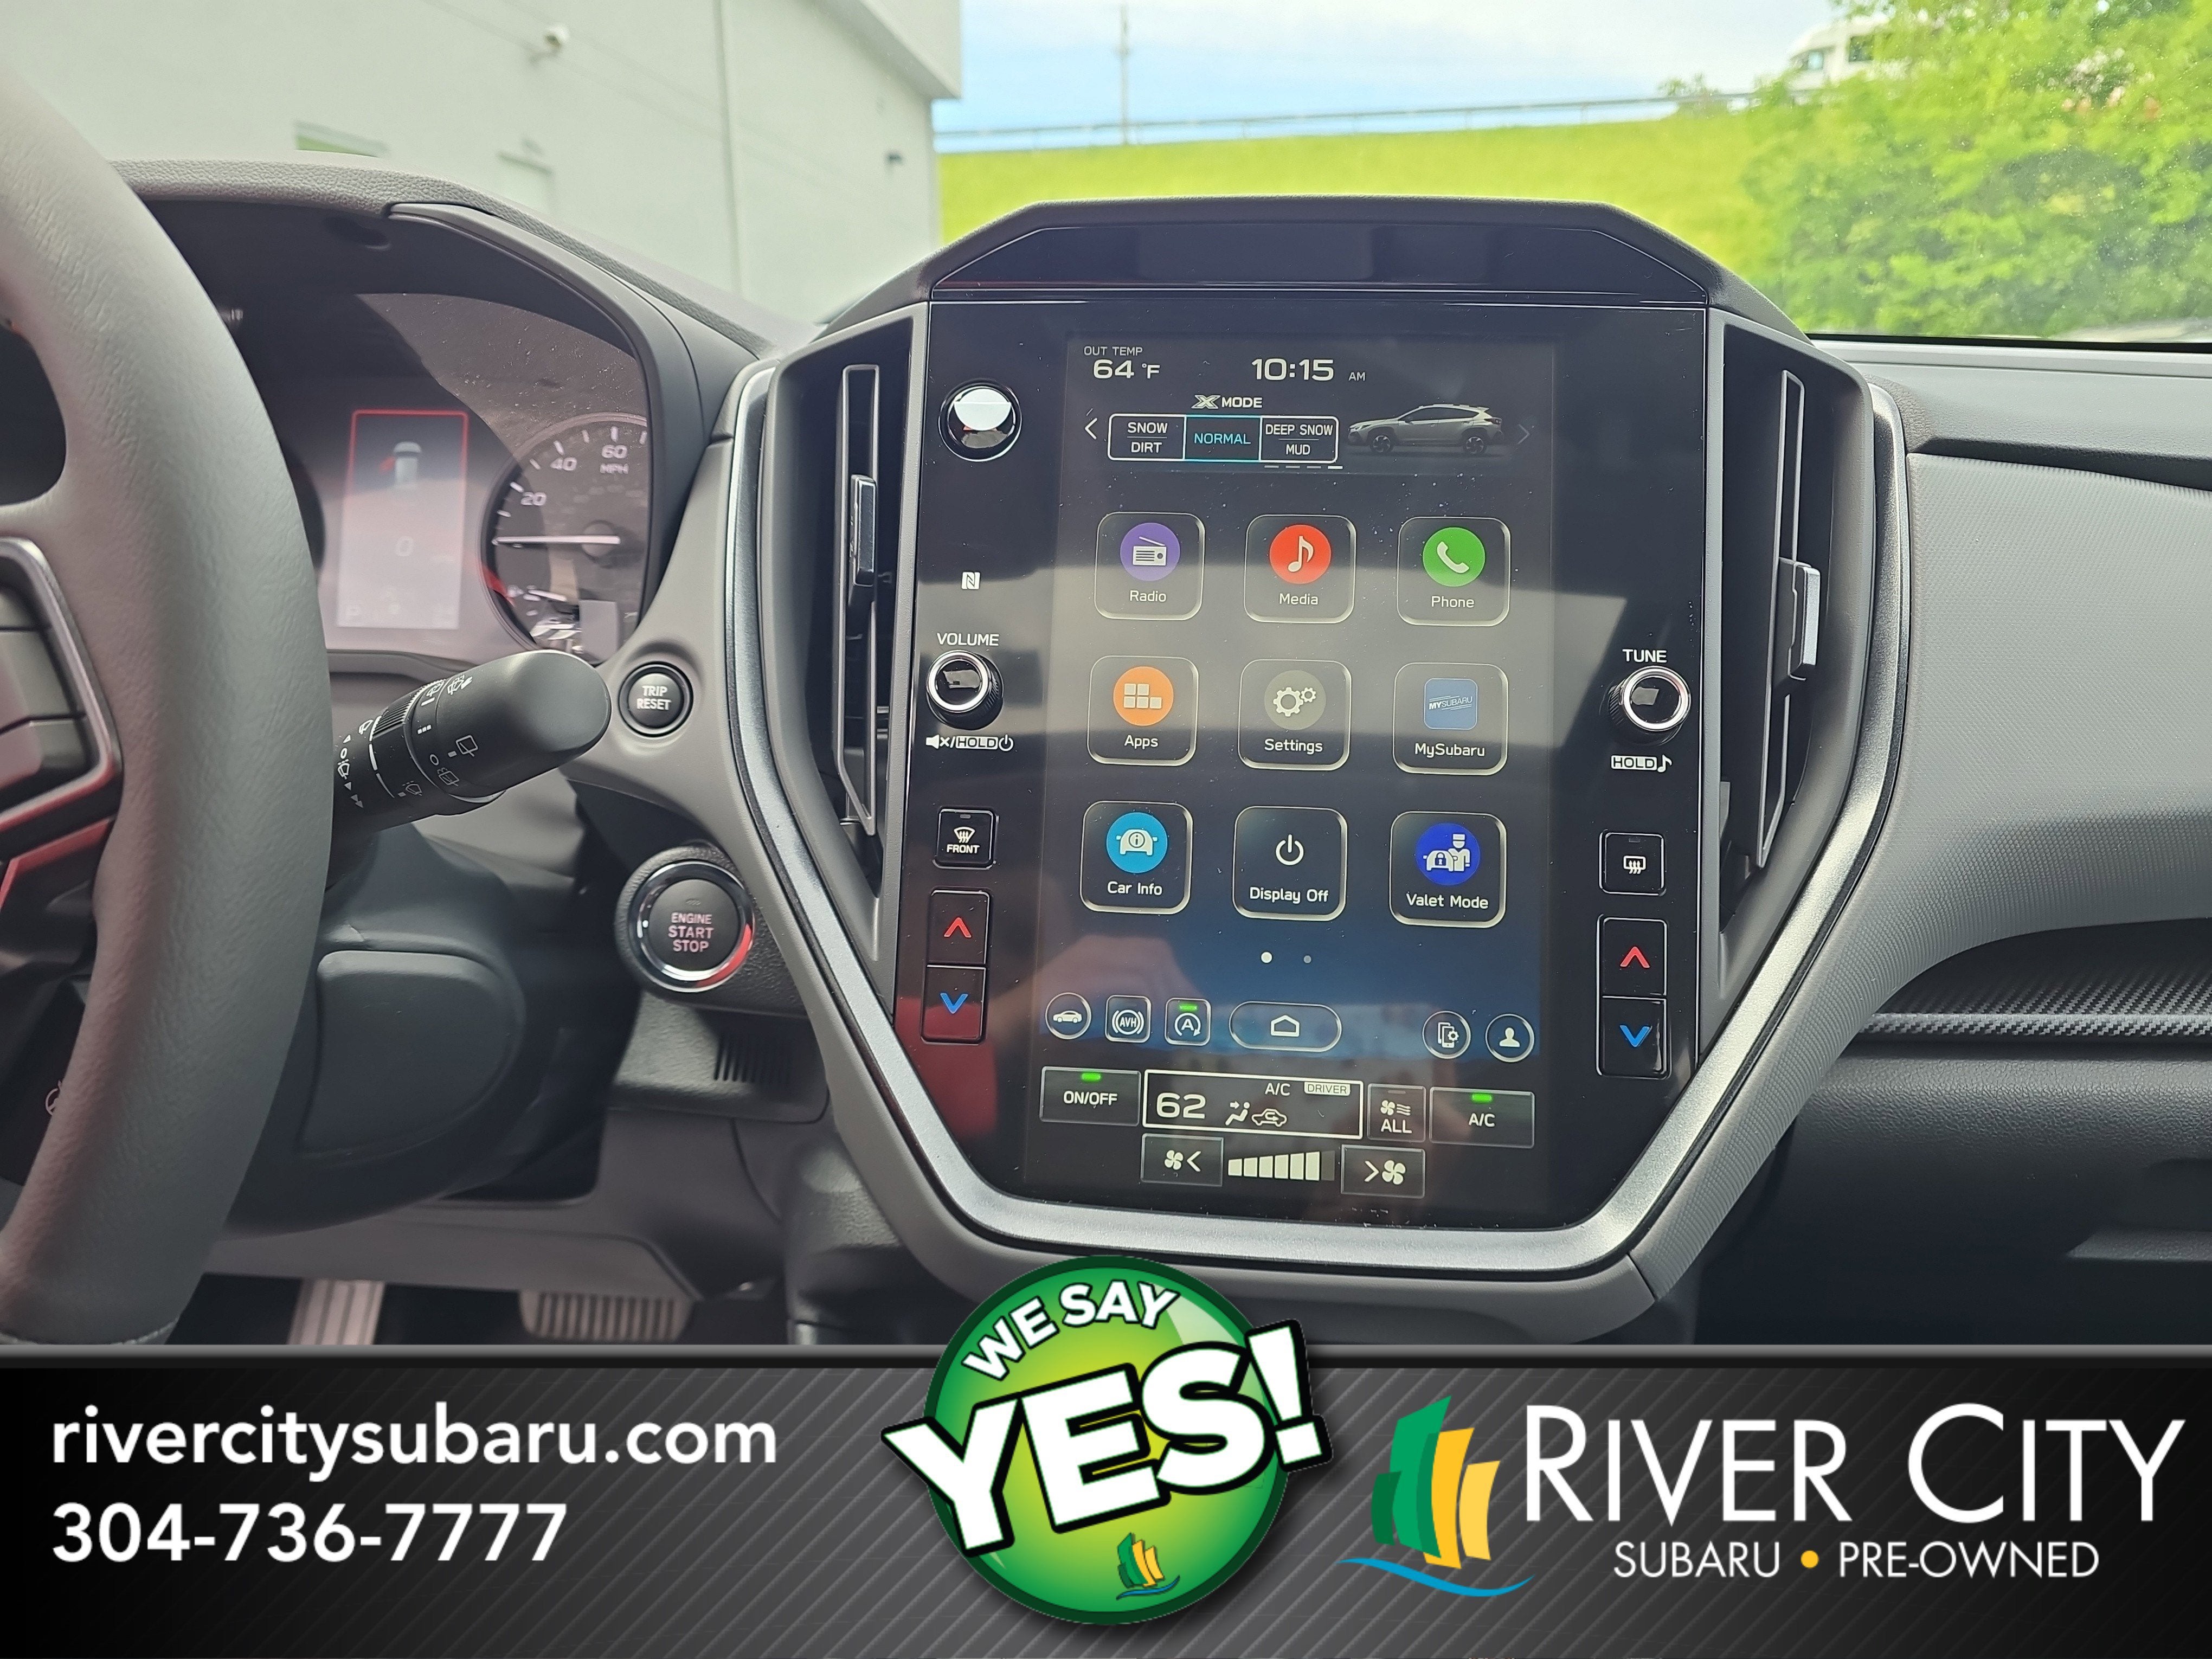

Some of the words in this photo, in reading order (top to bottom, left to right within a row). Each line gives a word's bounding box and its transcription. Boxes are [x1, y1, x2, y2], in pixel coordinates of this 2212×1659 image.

[1084, 346, 1108, 356] OUT
[1112, 346, 1143, 356] TEMP
[1094, 359, 1135, 378] 64
[1252, 358, 1335, 381] 10:15
[1348, 371, 1366, 381] AM
[1221, 397, 1263, 408] MODE
[1127, 422, 1168, 434] SNOW
[1265, 423, 1295, 435] DEEP
[1299, 424, 1333, 436] SNOW
[1194, 433, 1251, 445] NORMAL
[601, 444, 628, 459] 60
[1131, 441, 1162, 454] DIRT
[1285, 443, 1311, 455] MUD
[550, 456, 577, 471] 40
[520, 491, 546, 506] 20
[1129, 590, 1167, 603] Radio
[1279, 593, 1319, 606] Media
[1431, 596, 1475, 609] Phone
[937, 633, 999, 646] VOLUME
[1622, 649, 1667, 663] TUNE
[642, 685, 668, 697] TRIP
[636, 698, 672, 710] RESET
[1124, 735, 1159, 749] Apps
[1264, 738, 1323, 753] Settings
[1414, 743, 1485, 758] MySubaru
[1612, 756, 1656, 769] HOLD
[947, 844, 980, 854] FRONT
[1107, 882, 1131, 896] Car
[1137, 882, 1163, 896] Info
[1250, 886, 1301, 903] Display
[1307, 889, 1329, 903] Off
[1407, 893, 1445, 909] Valet
[1450, 896, 1489, 909] Mode
[671, 912, 712, 924] ENGINE
[667, 924, 715, 939] START
[673, 939, 709, 952] STOP
[1120, 1017, 1137, 1028] AVH
[1265, 1082, 1291, 1096] A/C
[1307, 1083, 1347, 1095] DRIVER
[1063, 1090, 1118, 1106] ON/OFF
[1156, 1092, 1206, 1120] 62
[1380, 1118, 1412, 1134] ALL
[1468, 1113, 1495, 1127] A/C
